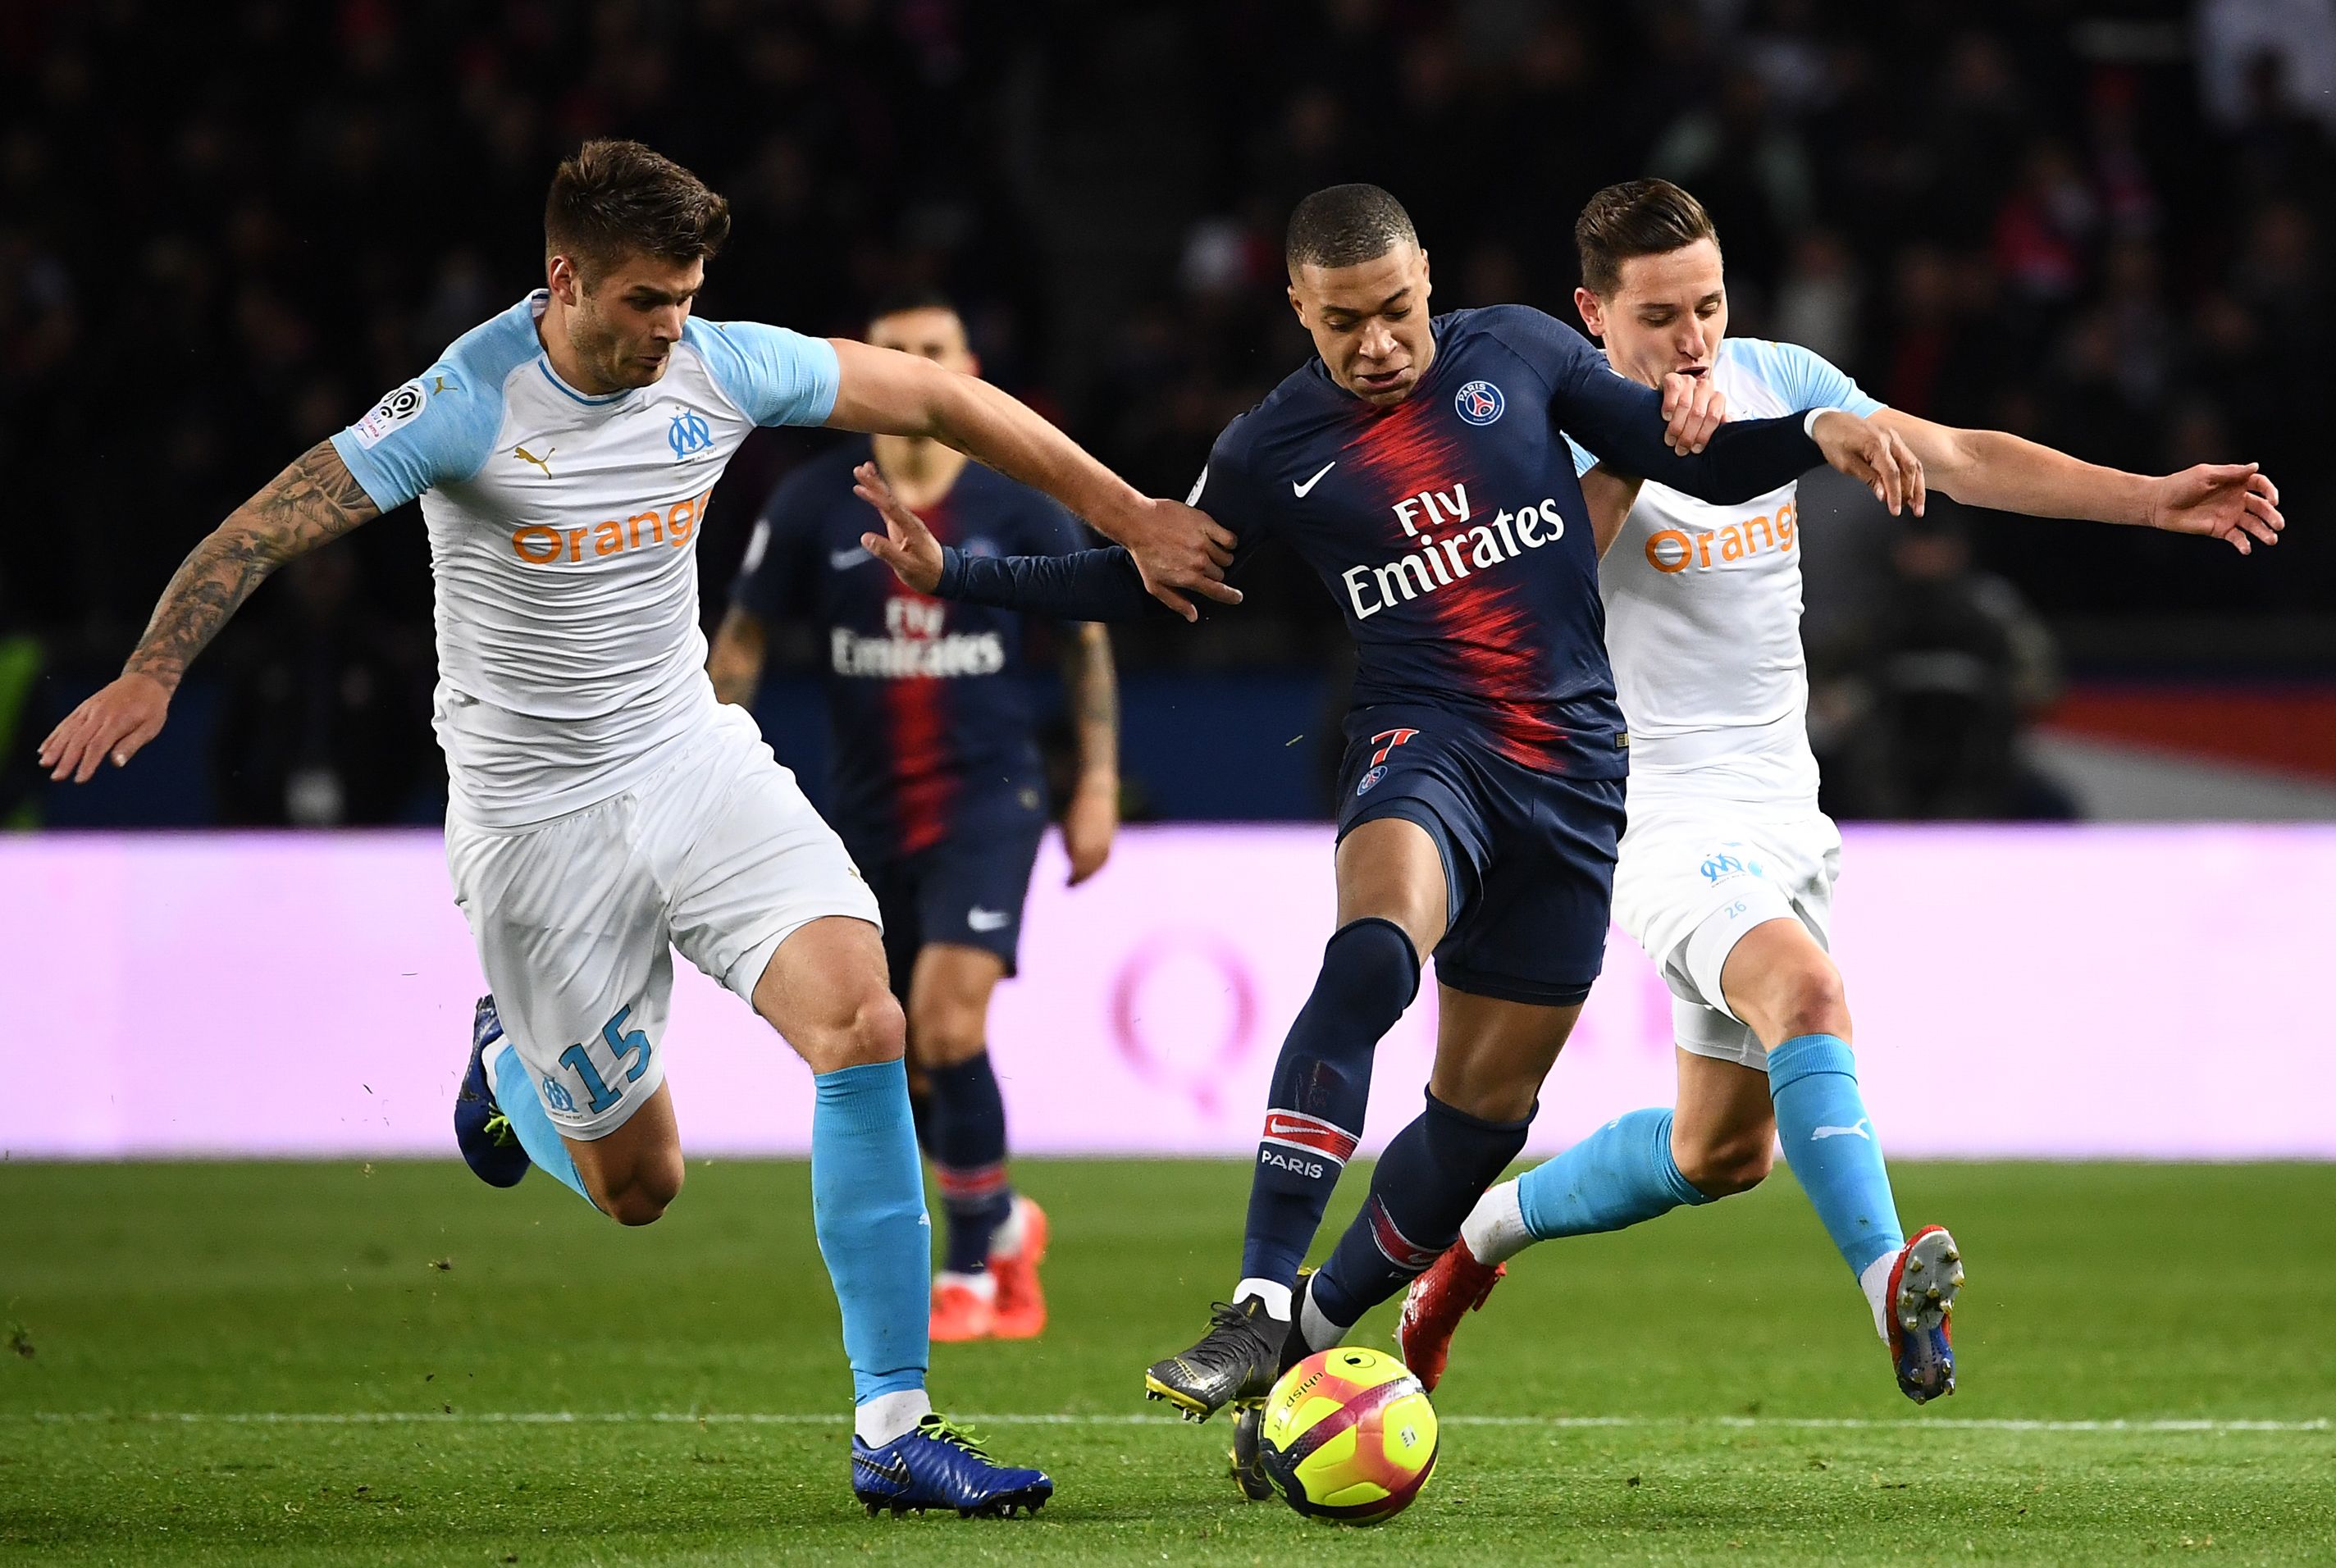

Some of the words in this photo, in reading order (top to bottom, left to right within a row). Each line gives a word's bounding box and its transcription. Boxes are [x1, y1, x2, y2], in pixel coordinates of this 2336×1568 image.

[1458, 383, 1486, 402] PARIS
[1392, 483, 1471, 537] Fly
[1645, 498, 1798, 572] Orang
[1342, 498, 1564, 620] Emirates
[1371, 727, 1420, 768] 7
[1724, 900, 1746, 919] 26
[559, 1003, 652, 1114] 15
[1262, 1150, 1323, 1179] PARIS
